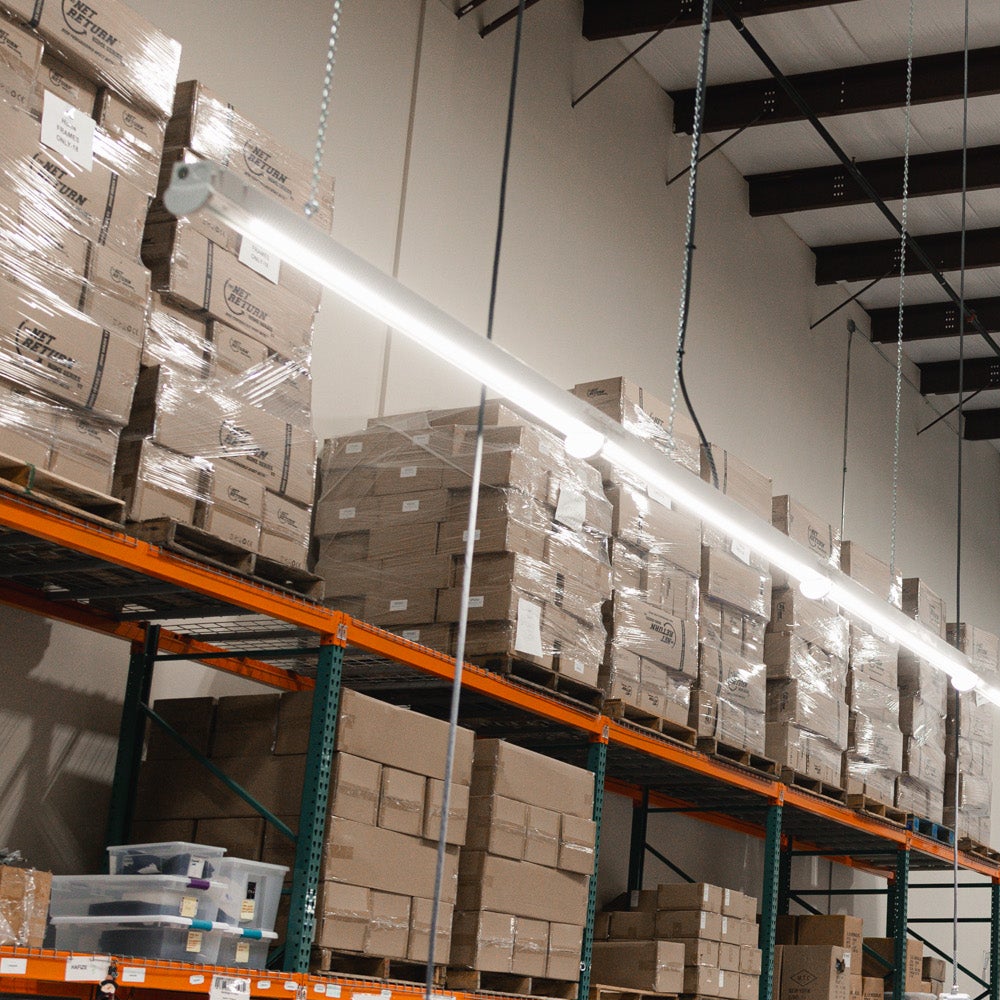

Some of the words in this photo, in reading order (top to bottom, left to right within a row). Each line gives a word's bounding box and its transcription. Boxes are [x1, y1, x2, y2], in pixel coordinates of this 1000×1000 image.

[73, 1, 98, 18] NET
[66, 8, 118, 46] RETURN
[252, 145, 272, 162] NET
[43, 161, 68, 180] NET
[247, 154, 288, 184] RETURN
[231, 284, 251, 300] NET
[227, 292, 269, 321] RETURN
[31, 327, 57, 346] NET
[650, 623, 674, 638] RETURN
